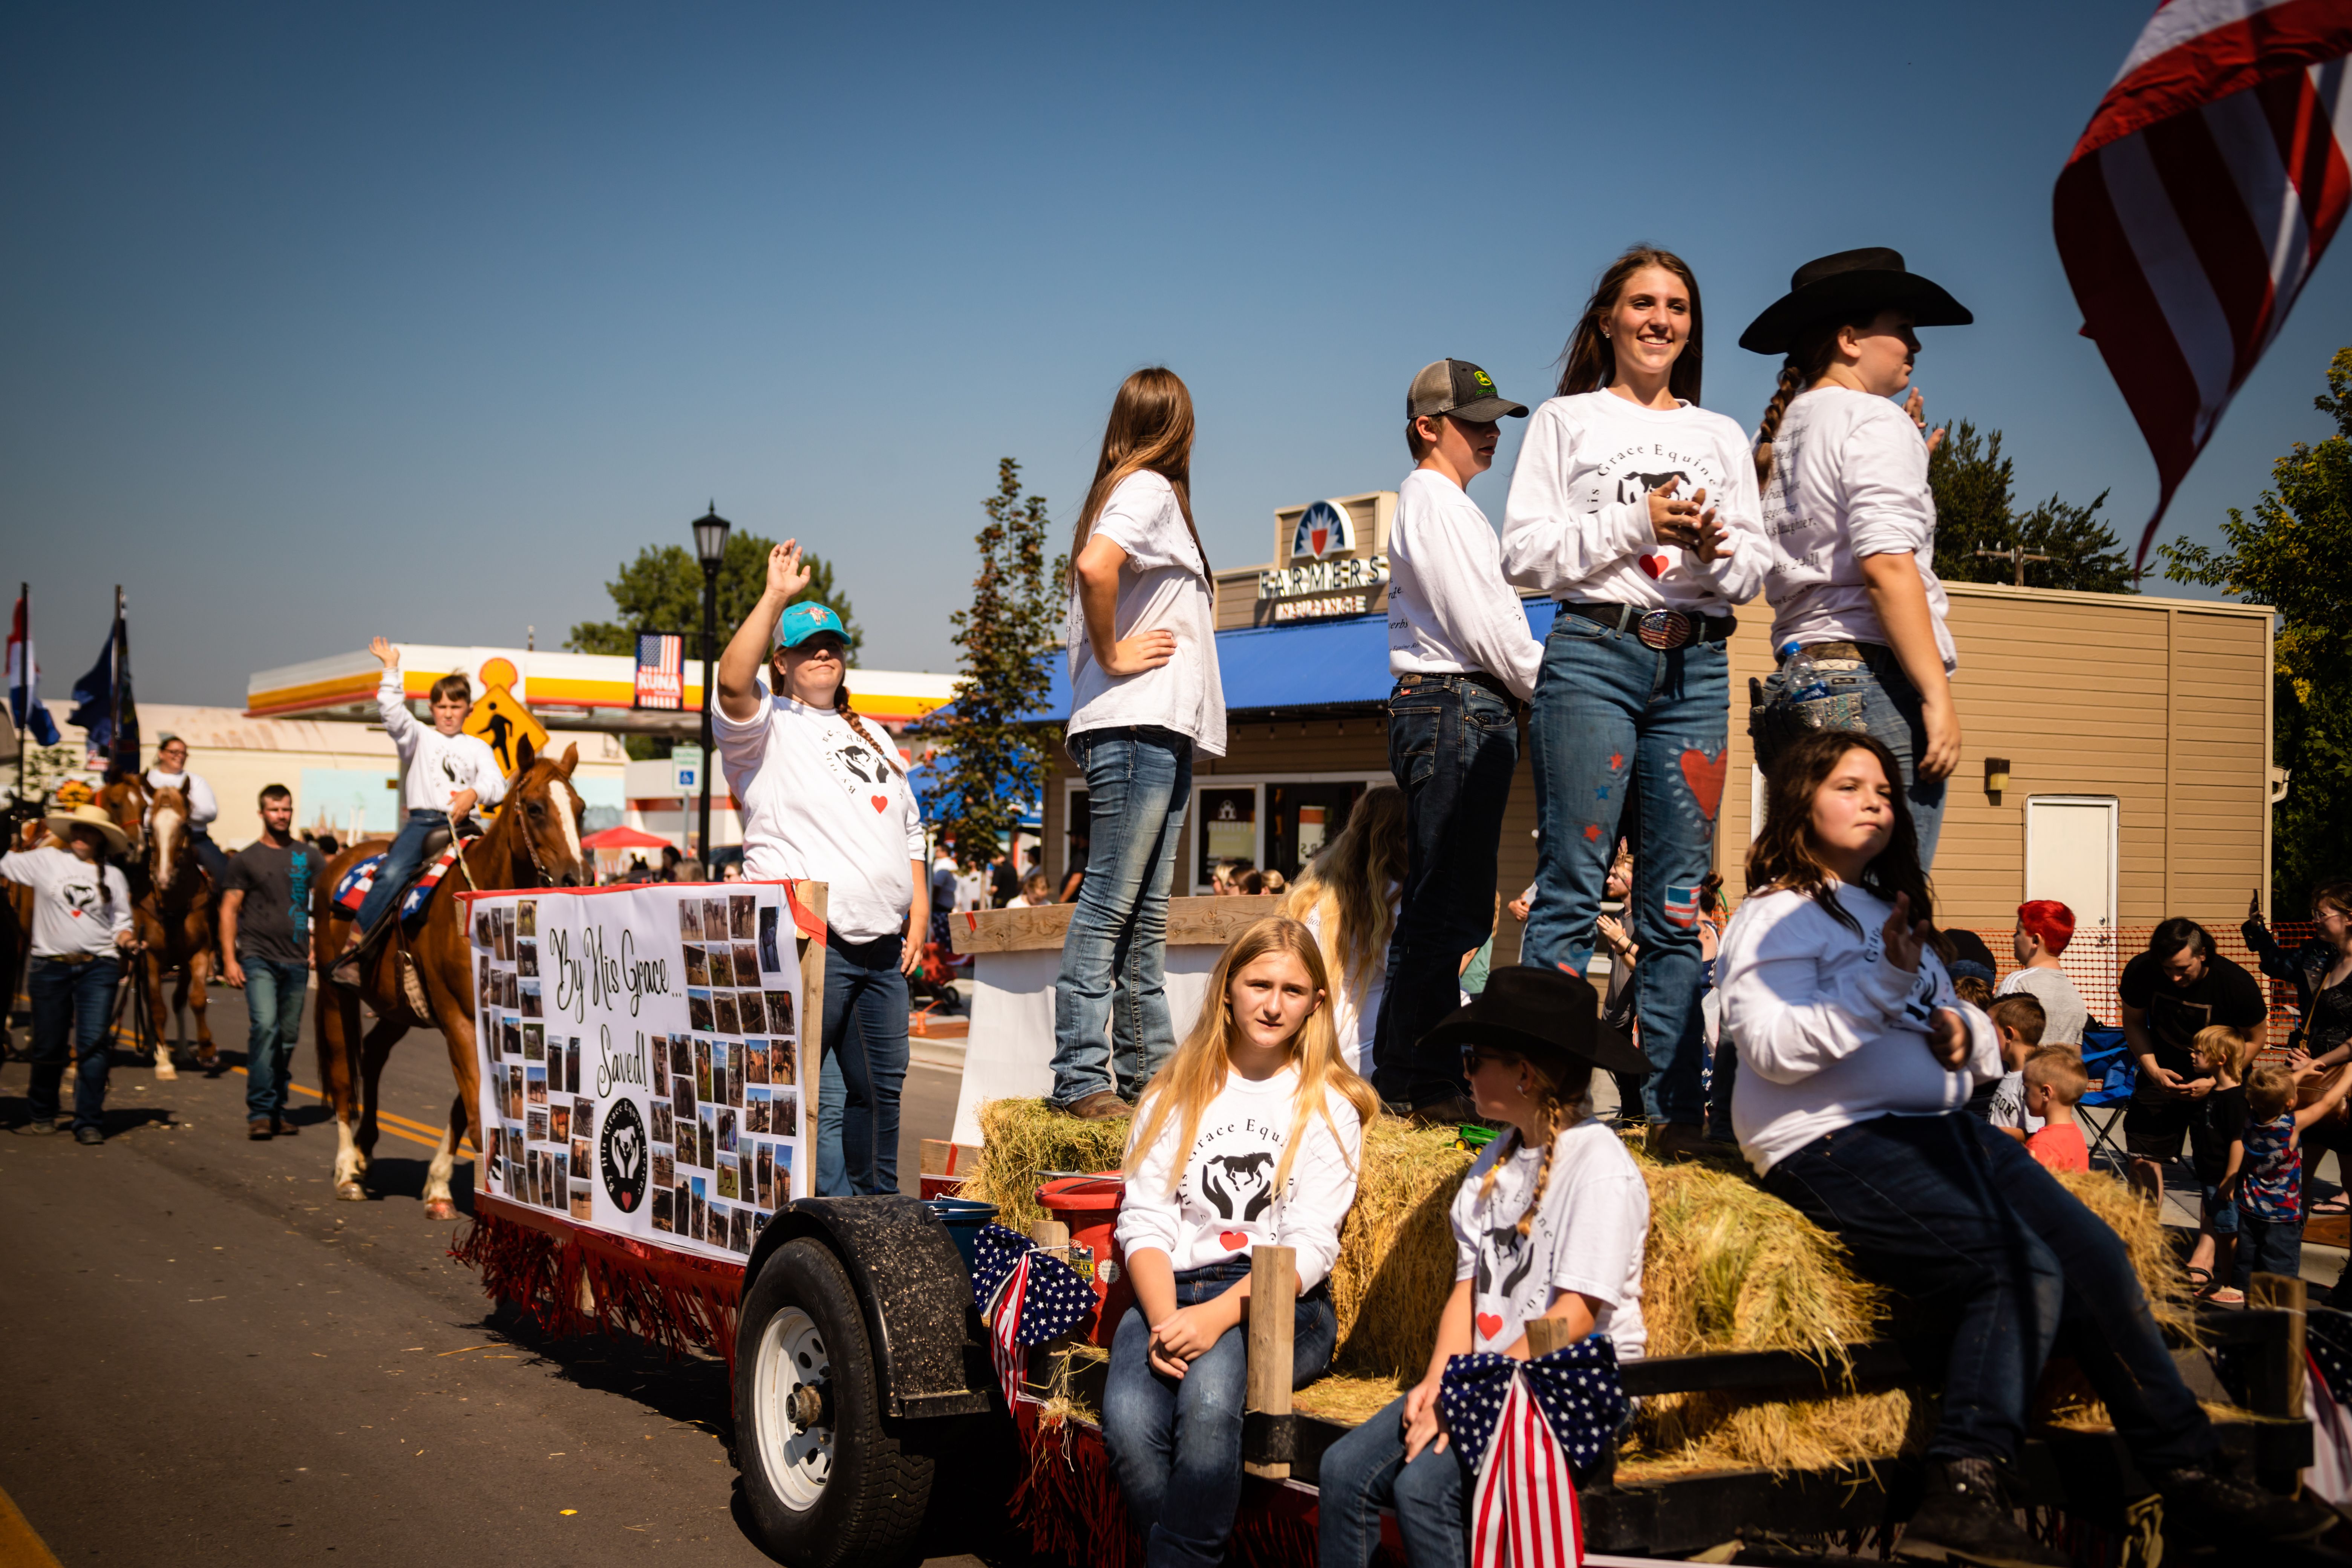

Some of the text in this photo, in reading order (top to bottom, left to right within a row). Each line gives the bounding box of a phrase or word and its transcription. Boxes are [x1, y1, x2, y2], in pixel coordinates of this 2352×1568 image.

[1587, 444, 1716, 514] is Grace Equine
[1258, 556, 1389, 599] FARMERS
[1275, 595, 1366, 621] INSURANCE
[1070, 641, 1083, 651] quine
[637, 672, 680, 691] KUNA
[1865, 926, 1883, 962] Grac
[550, 928, 585, 1023] By
[583, 925, 619, 1011] His
[597, 1024, 648, 1098] Saved!
[603, 1105, 623, 1135] Grace
[624, 1101, 644, 1137] Equine
[1180, 1174, 1191, 1206] His
